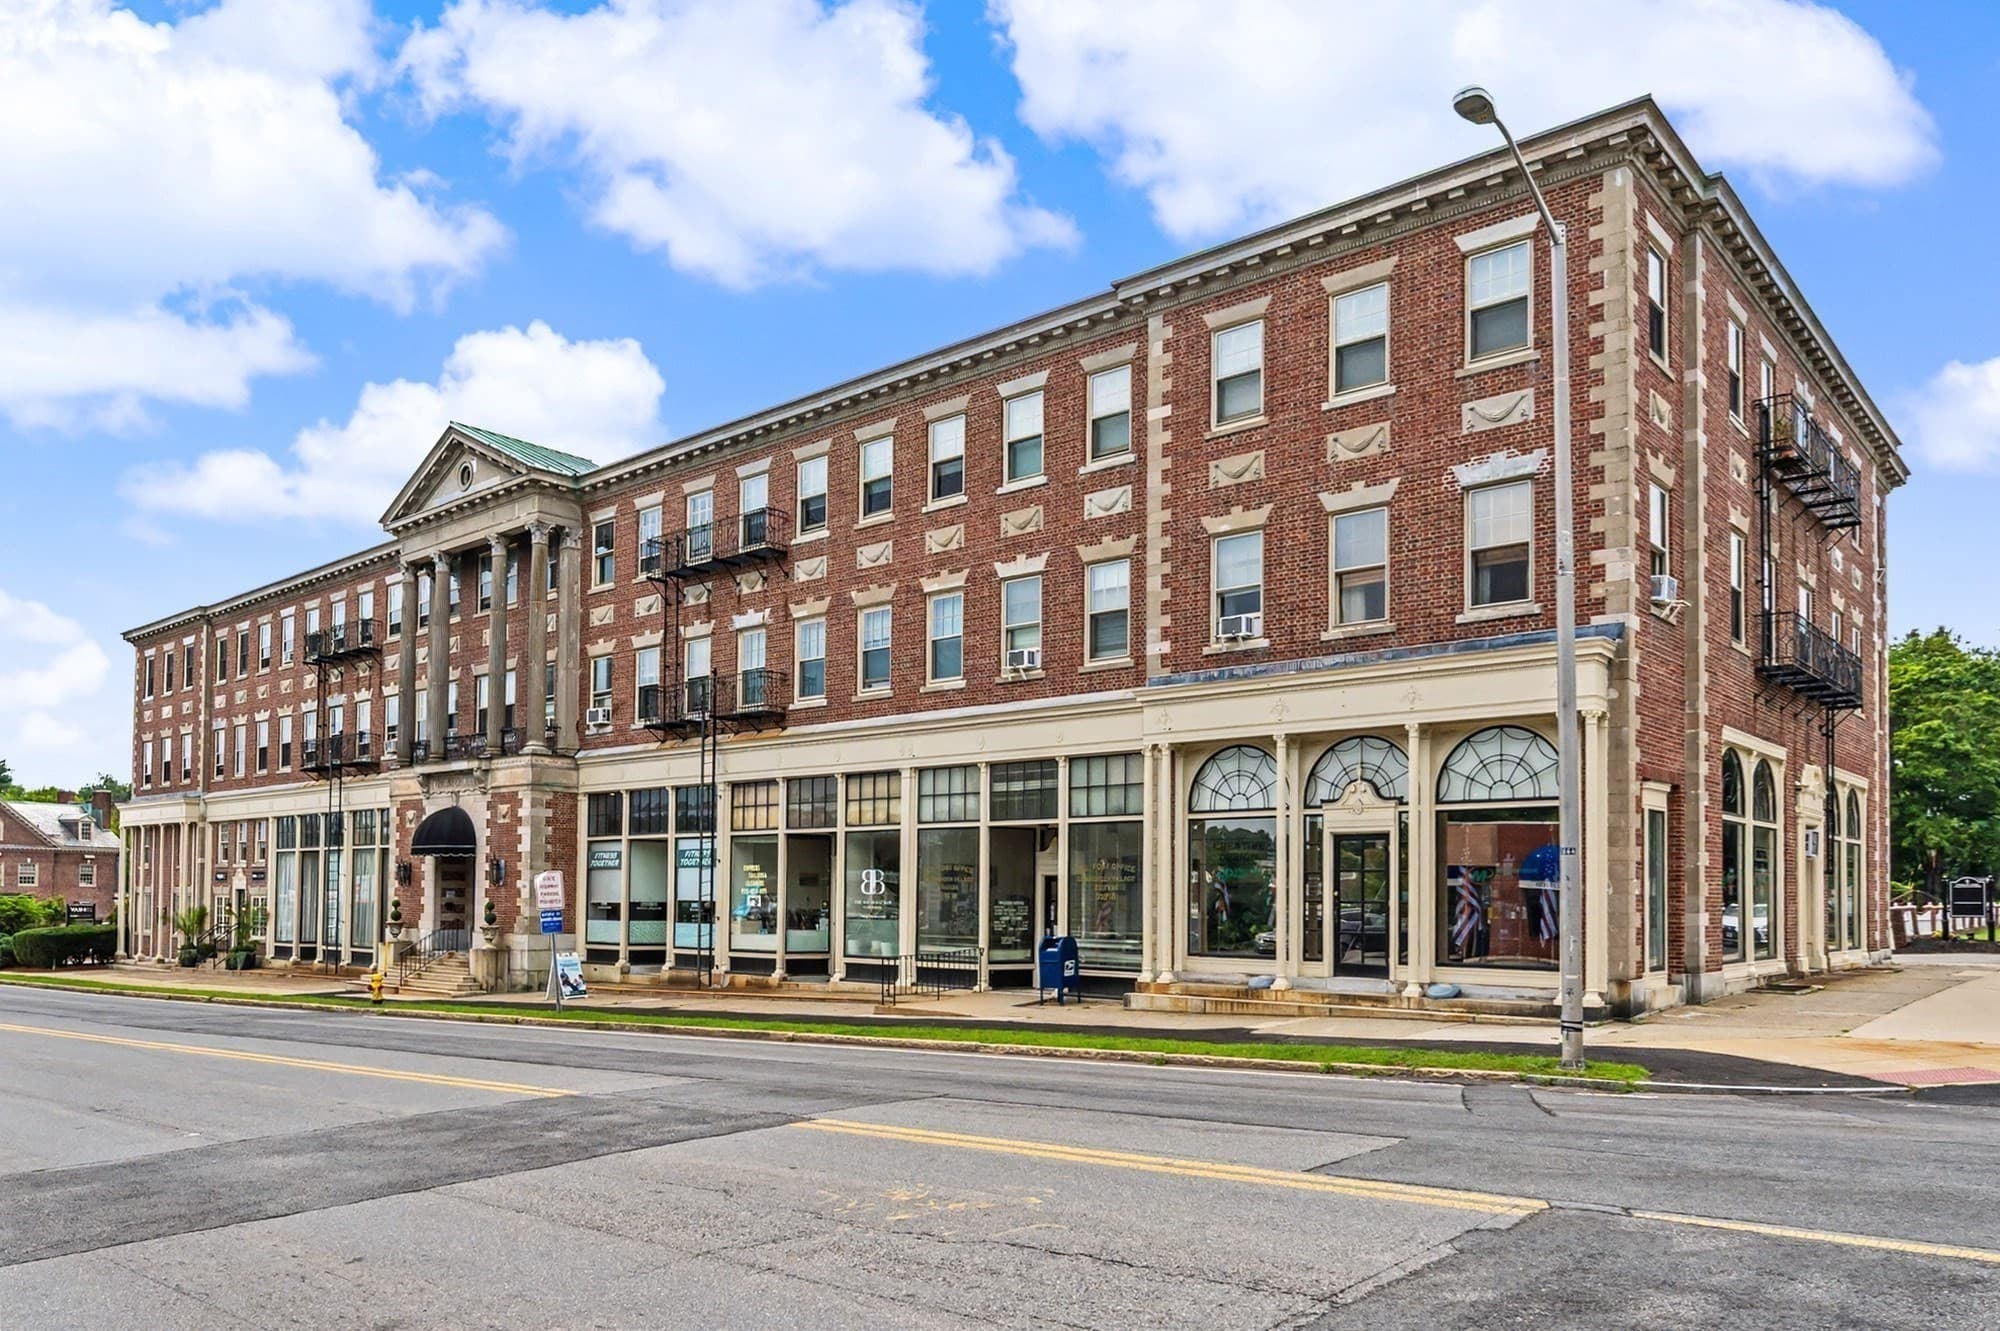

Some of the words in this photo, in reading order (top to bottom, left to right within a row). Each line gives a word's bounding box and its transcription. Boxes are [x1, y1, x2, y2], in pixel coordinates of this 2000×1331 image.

[594, 851, 618, 859] FITNESS
[684, 850, 711, 858] FITNSS
[590, 859, 620, 867] TOGETHER
[679, 858, 712, 866] TOGETER
